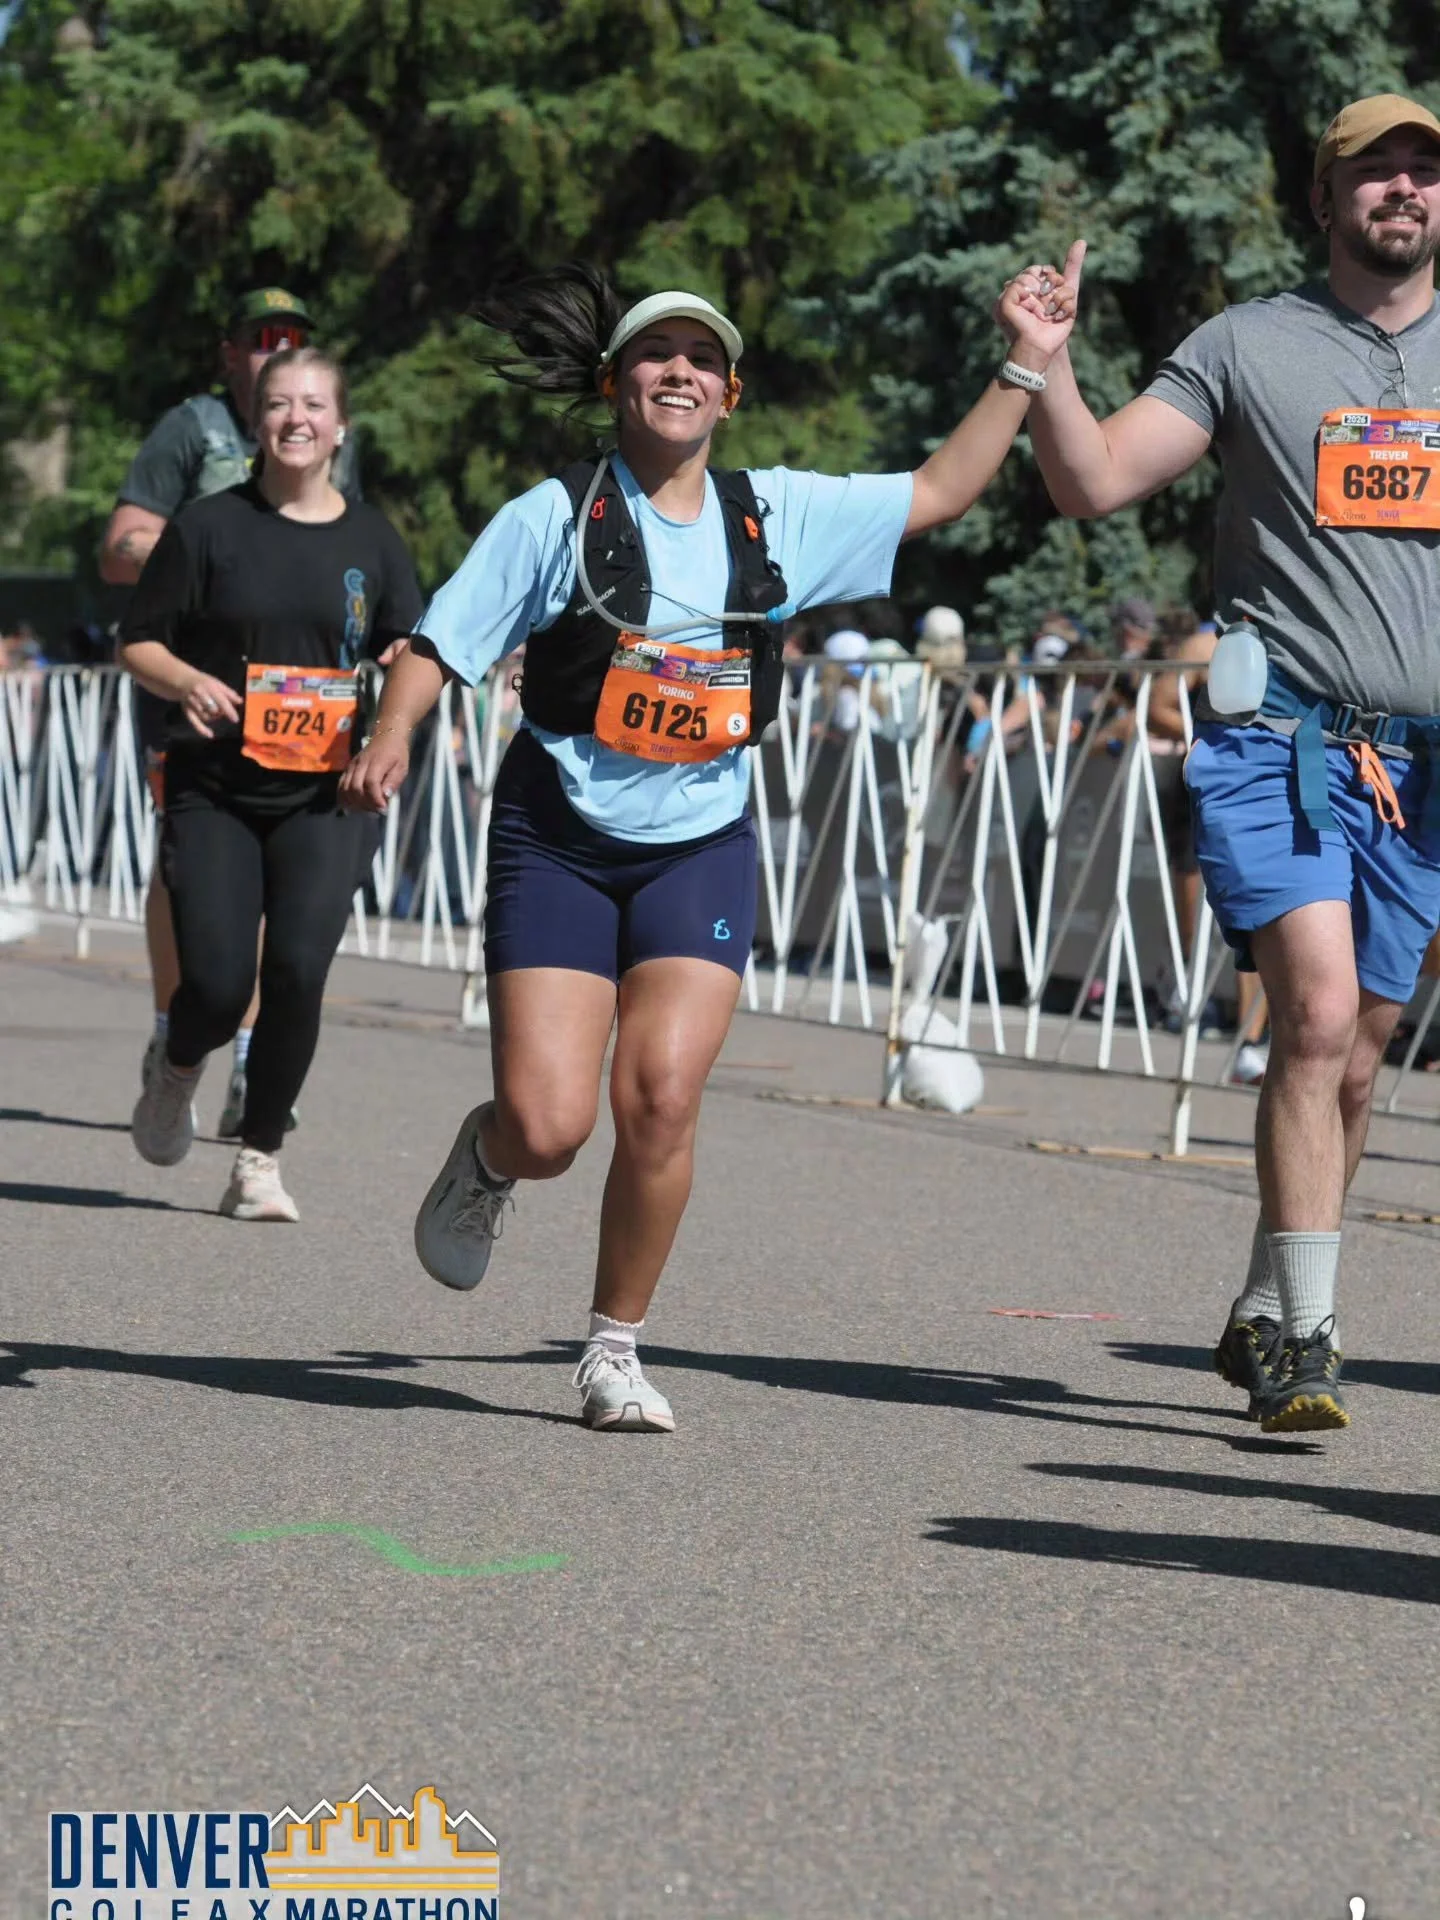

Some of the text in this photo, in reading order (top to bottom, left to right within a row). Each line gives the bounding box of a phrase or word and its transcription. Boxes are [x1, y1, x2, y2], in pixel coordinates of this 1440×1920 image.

[1346, 415, 1367, 424] 2026
[1369, 450, 1409, 461] TREVER
[1343, 464, 1431, 501] 6387
[576, 586, 616, 616] SALMON
[657, 683, 695, 700] YORIKO
[263, 708, 326, 737] 6724
[622, 692, 708, 742] 6125
[733, 719, 740, 731] S
